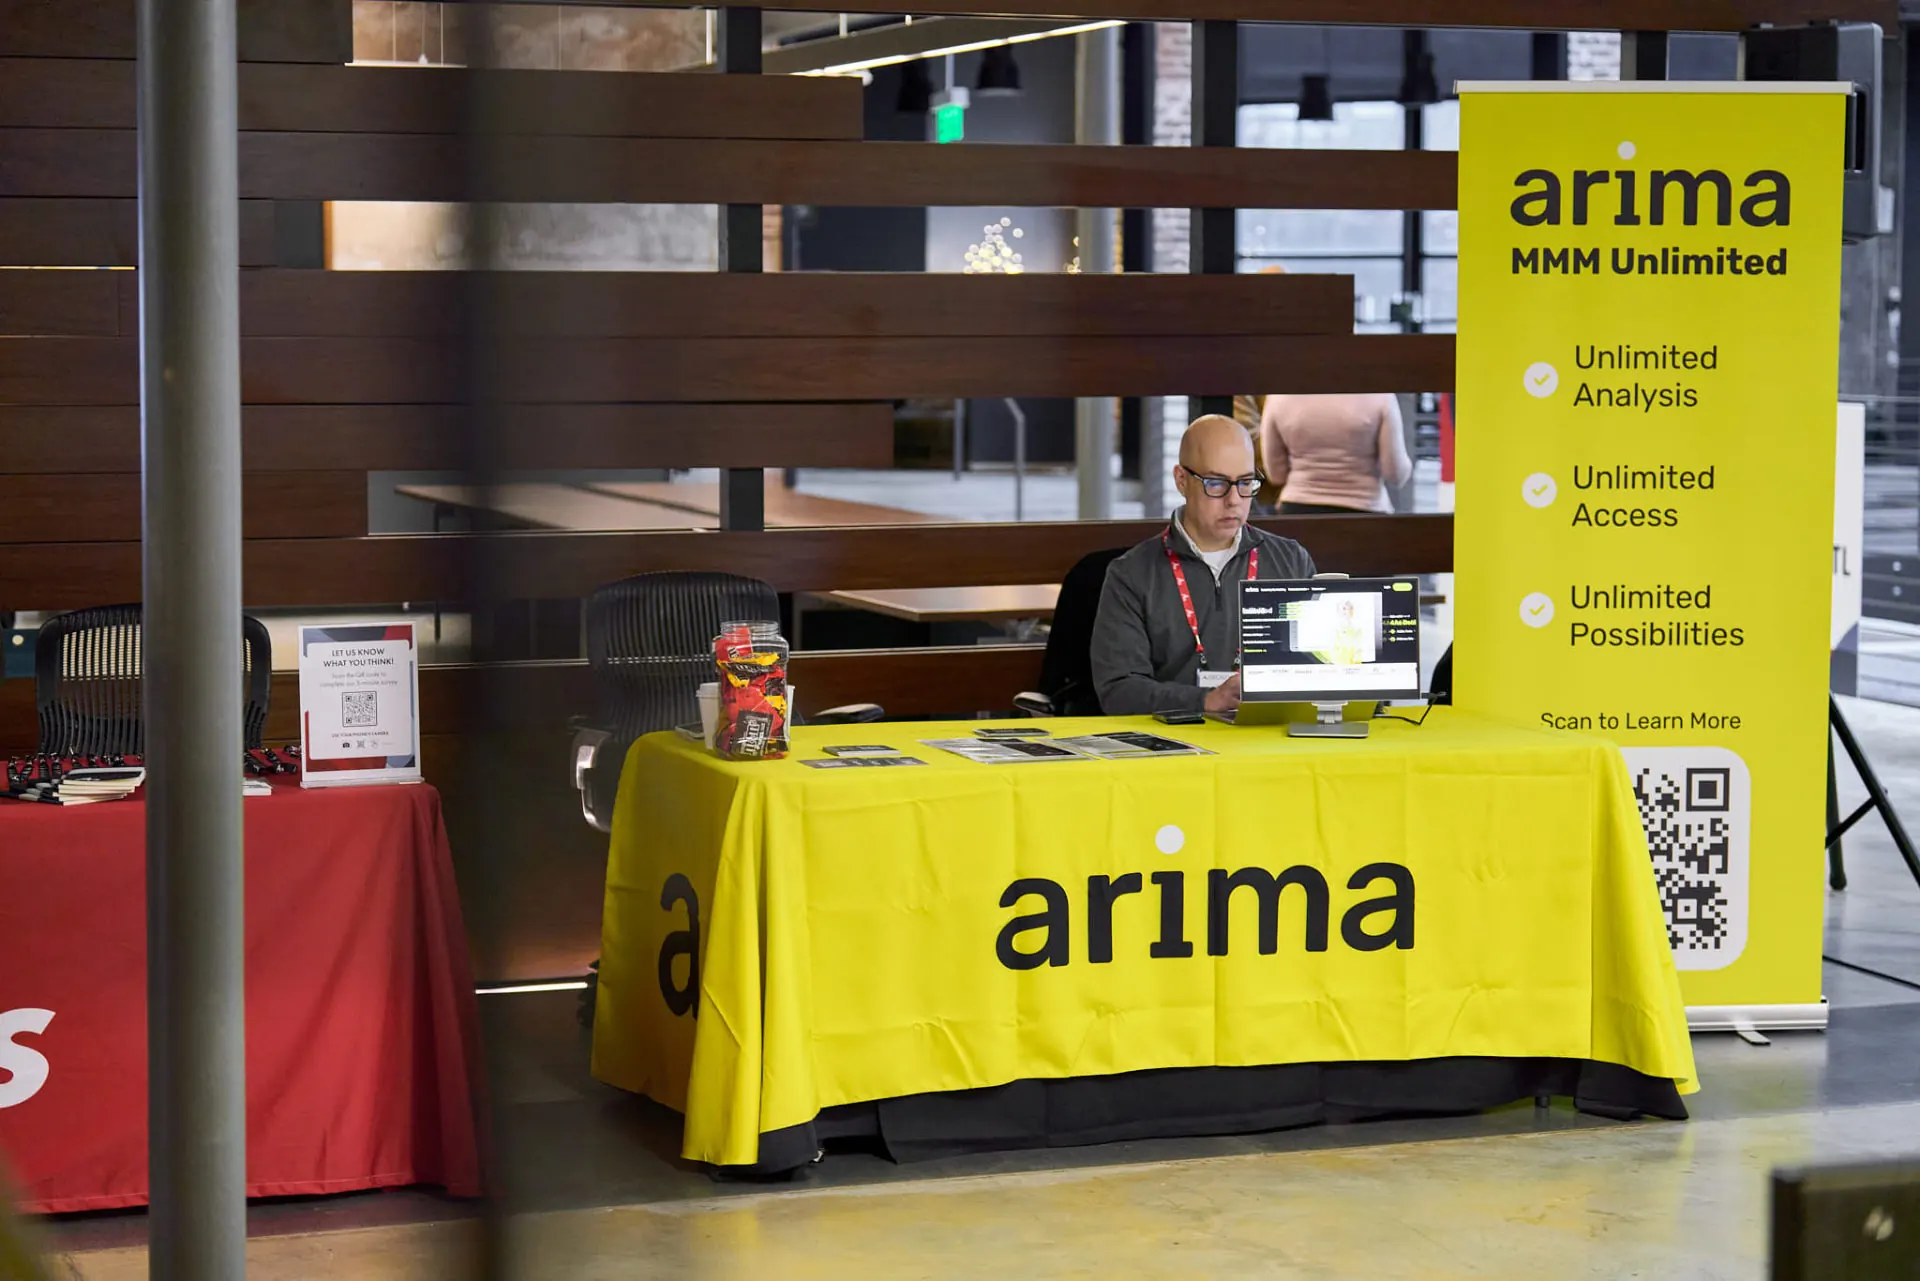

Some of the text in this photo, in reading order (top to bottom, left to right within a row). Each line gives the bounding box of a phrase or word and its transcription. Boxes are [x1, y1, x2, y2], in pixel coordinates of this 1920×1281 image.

[1510, 141, 1791, 227] arima
[1511, 246, 1787, 276] MMM Unlimited
[1575, 344, 1718, 370] Unlimited
[1573, 382, 1698, 413] Analysis
[1573, 465, 1715, 490] Unlimited
[1571, 503, 1679, 527] Access
[1571, 584, 1712, 609] Unlimited
[1570, 622, 1744, 647] Possibilities
[323, 659, 347, 667] WHAT
[368, 658, 394, 666] THINK!
[331, 649, 344, 657] LET
[357, 648, 385, 656] KNOW
[1541, 712, 1742, 730] Scan to Learn More
[995, 824, 1416, 971] arima
